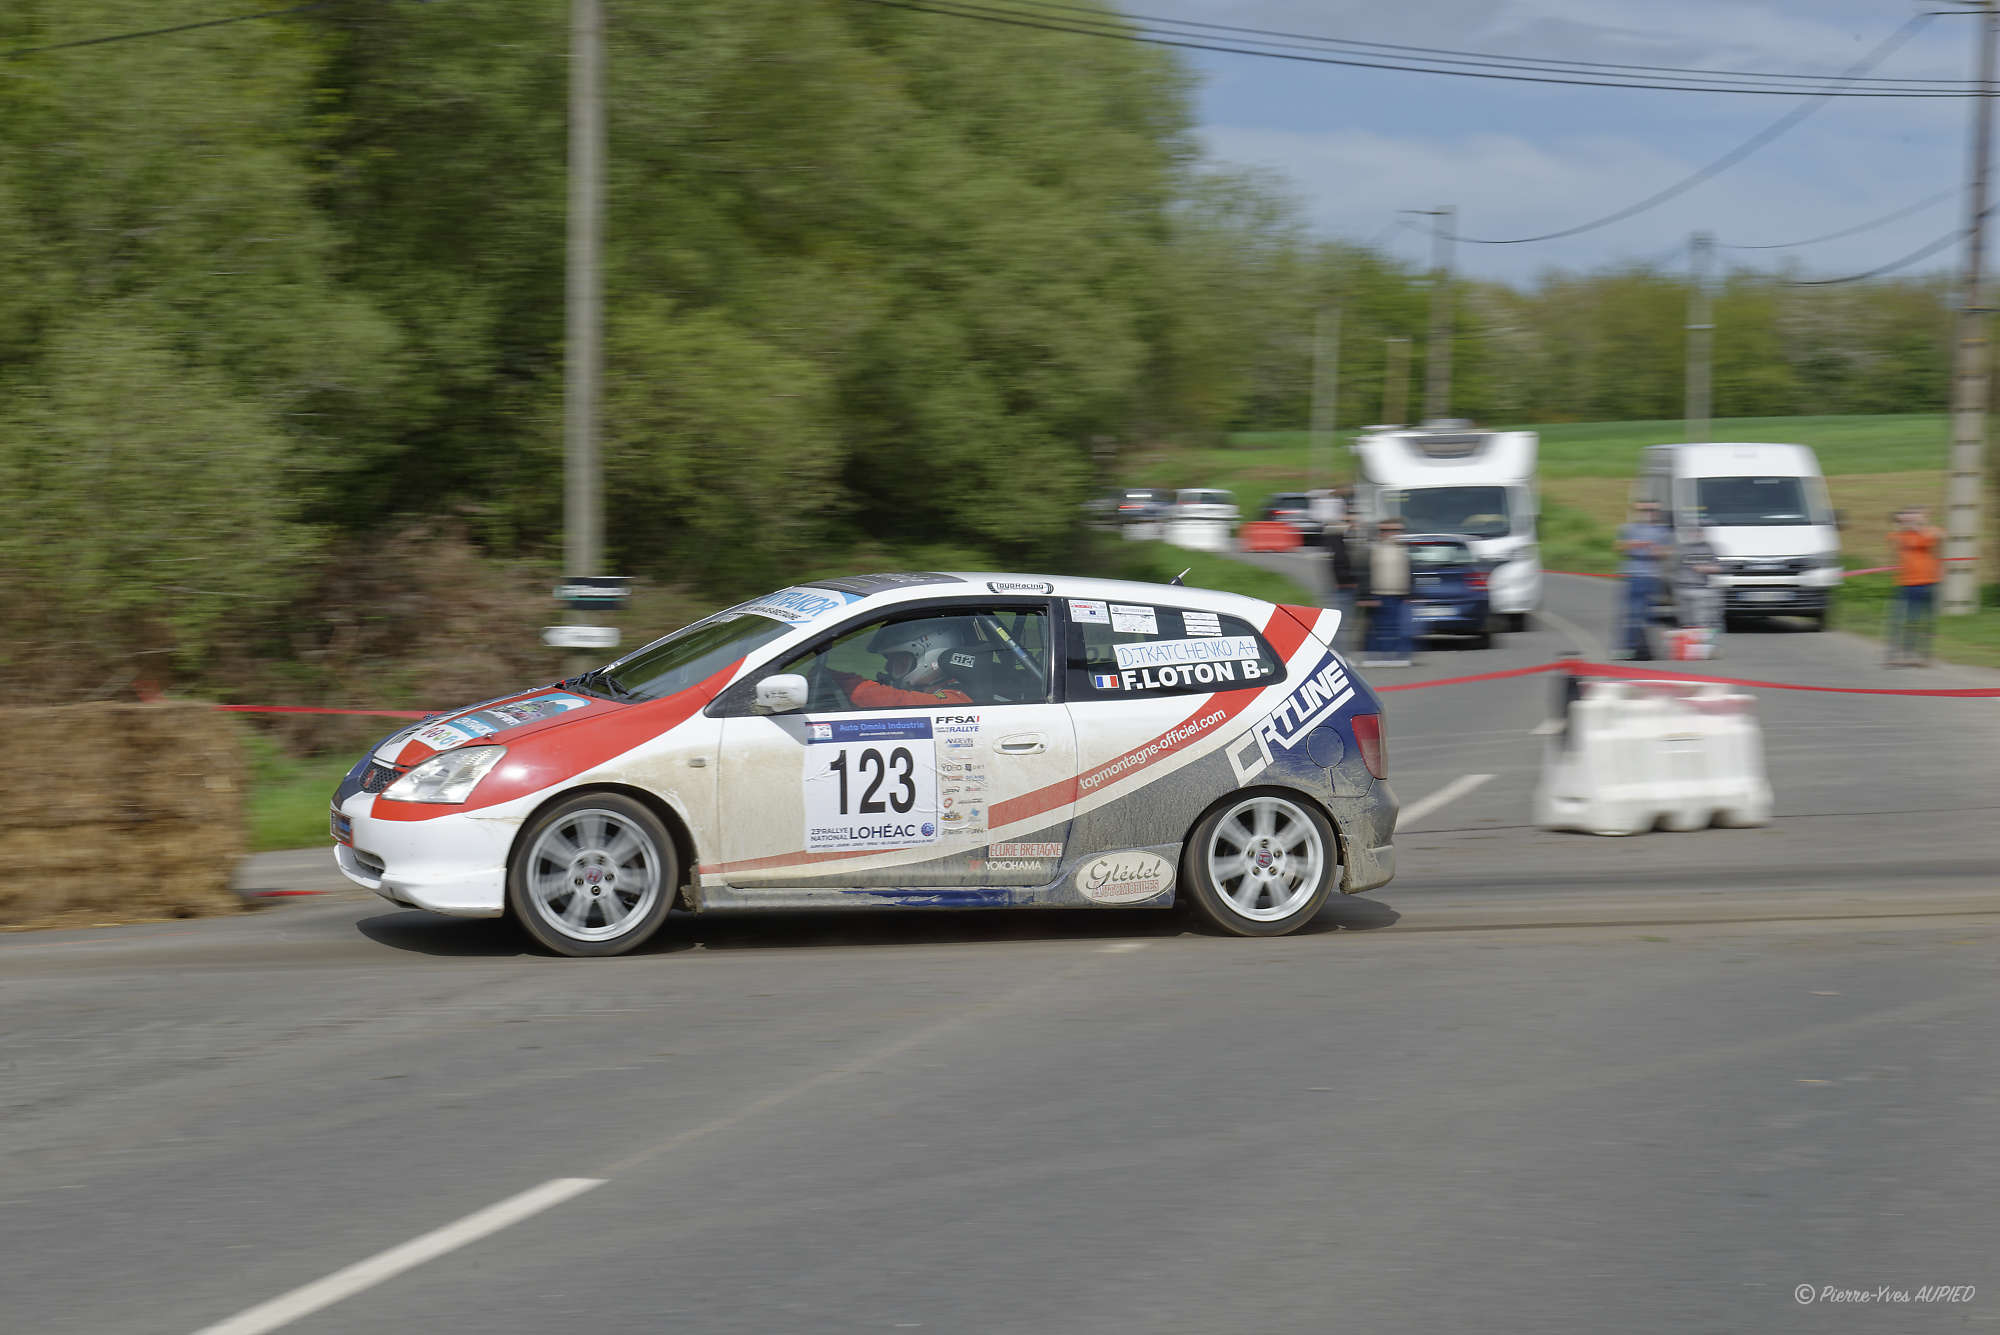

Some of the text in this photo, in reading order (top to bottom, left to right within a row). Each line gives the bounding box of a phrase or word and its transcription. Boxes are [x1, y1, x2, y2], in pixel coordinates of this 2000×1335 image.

[1121, 662, 1236, 690] F.LOTON
[935, 715, 976, 724] FFSA
[1079, 708, 1227, 790] topmontagne-officiel.com
[830, 747, 916, 815] 123
[850, 823, 916, 839] LOHÉAC
[1020, 843, 1061, 857] BRETAGNE
[985, 860, 1042, 871] YOKOHAMA
